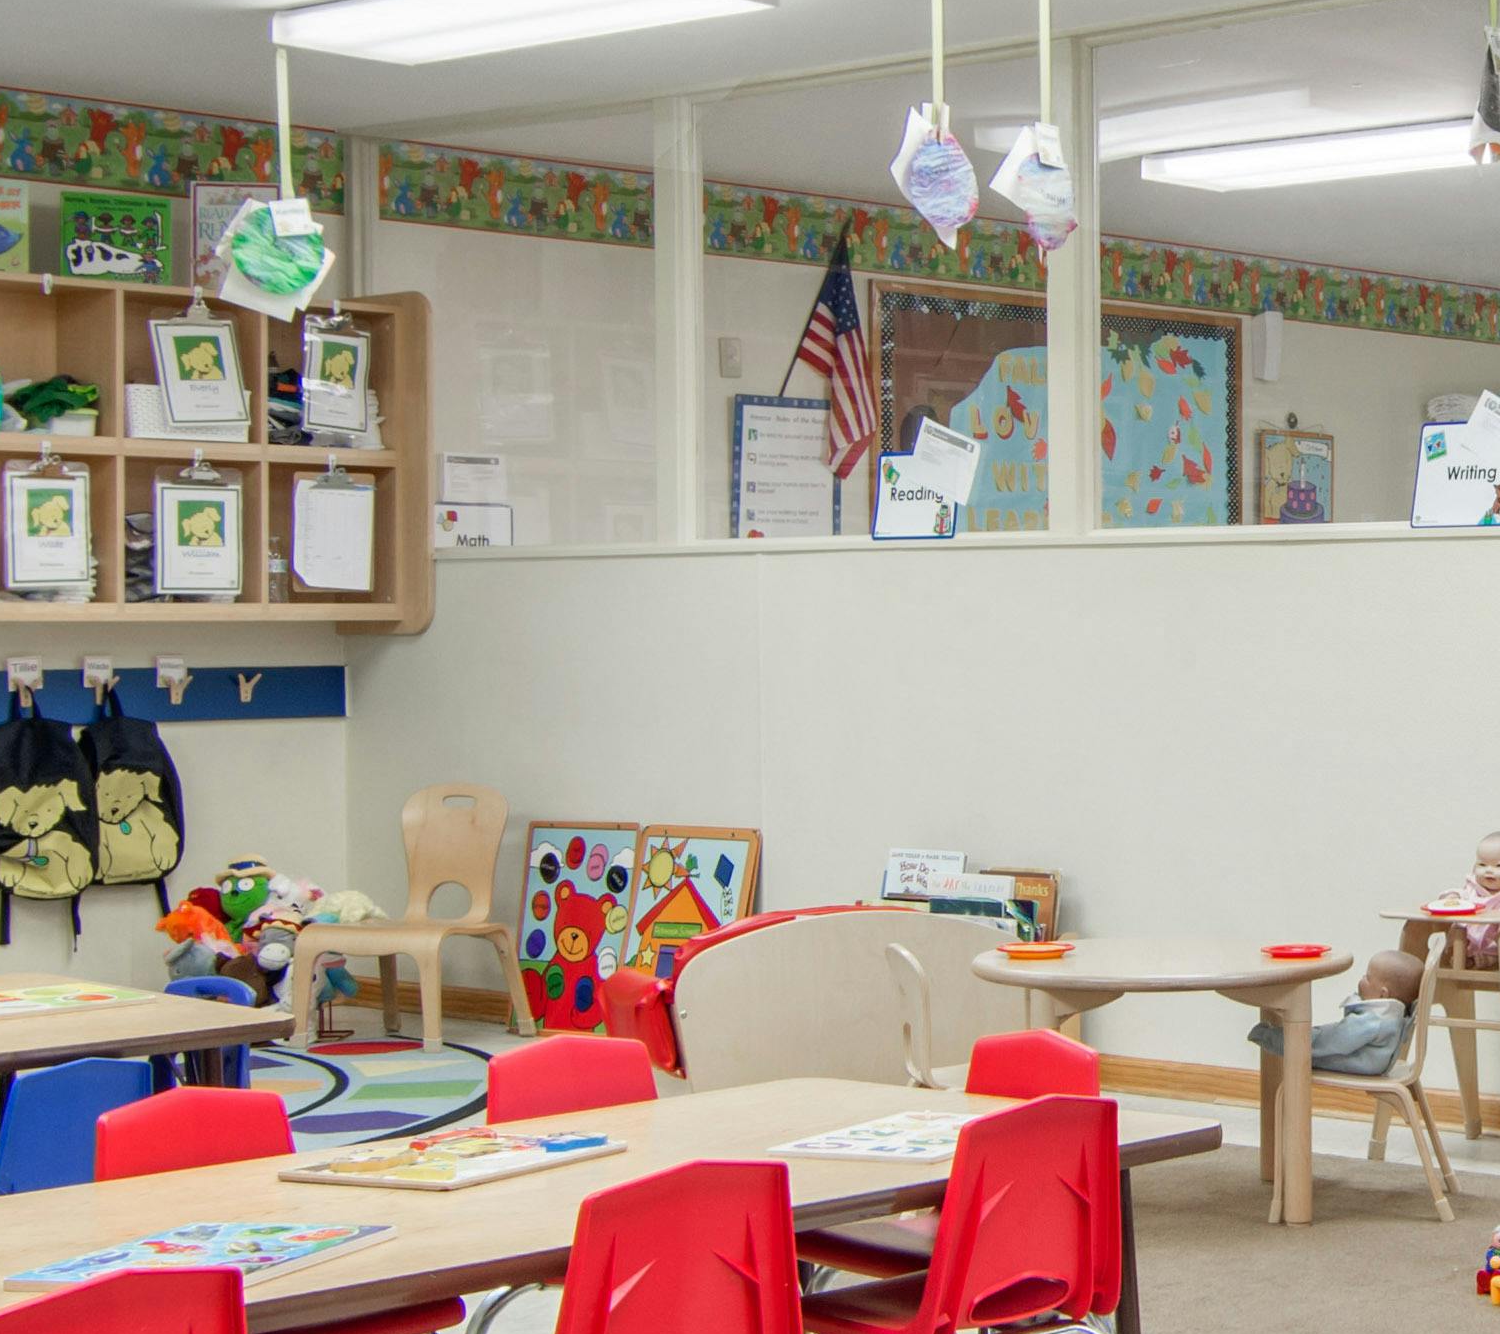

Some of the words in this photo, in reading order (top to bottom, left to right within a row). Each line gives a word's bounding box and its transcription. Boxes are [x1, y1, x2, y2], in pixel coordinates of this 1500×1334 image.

[1447, 465, 1498, 483] Writing
[455, 533, 490, 547] Math
[11, 662, 39, 673] Tillie
